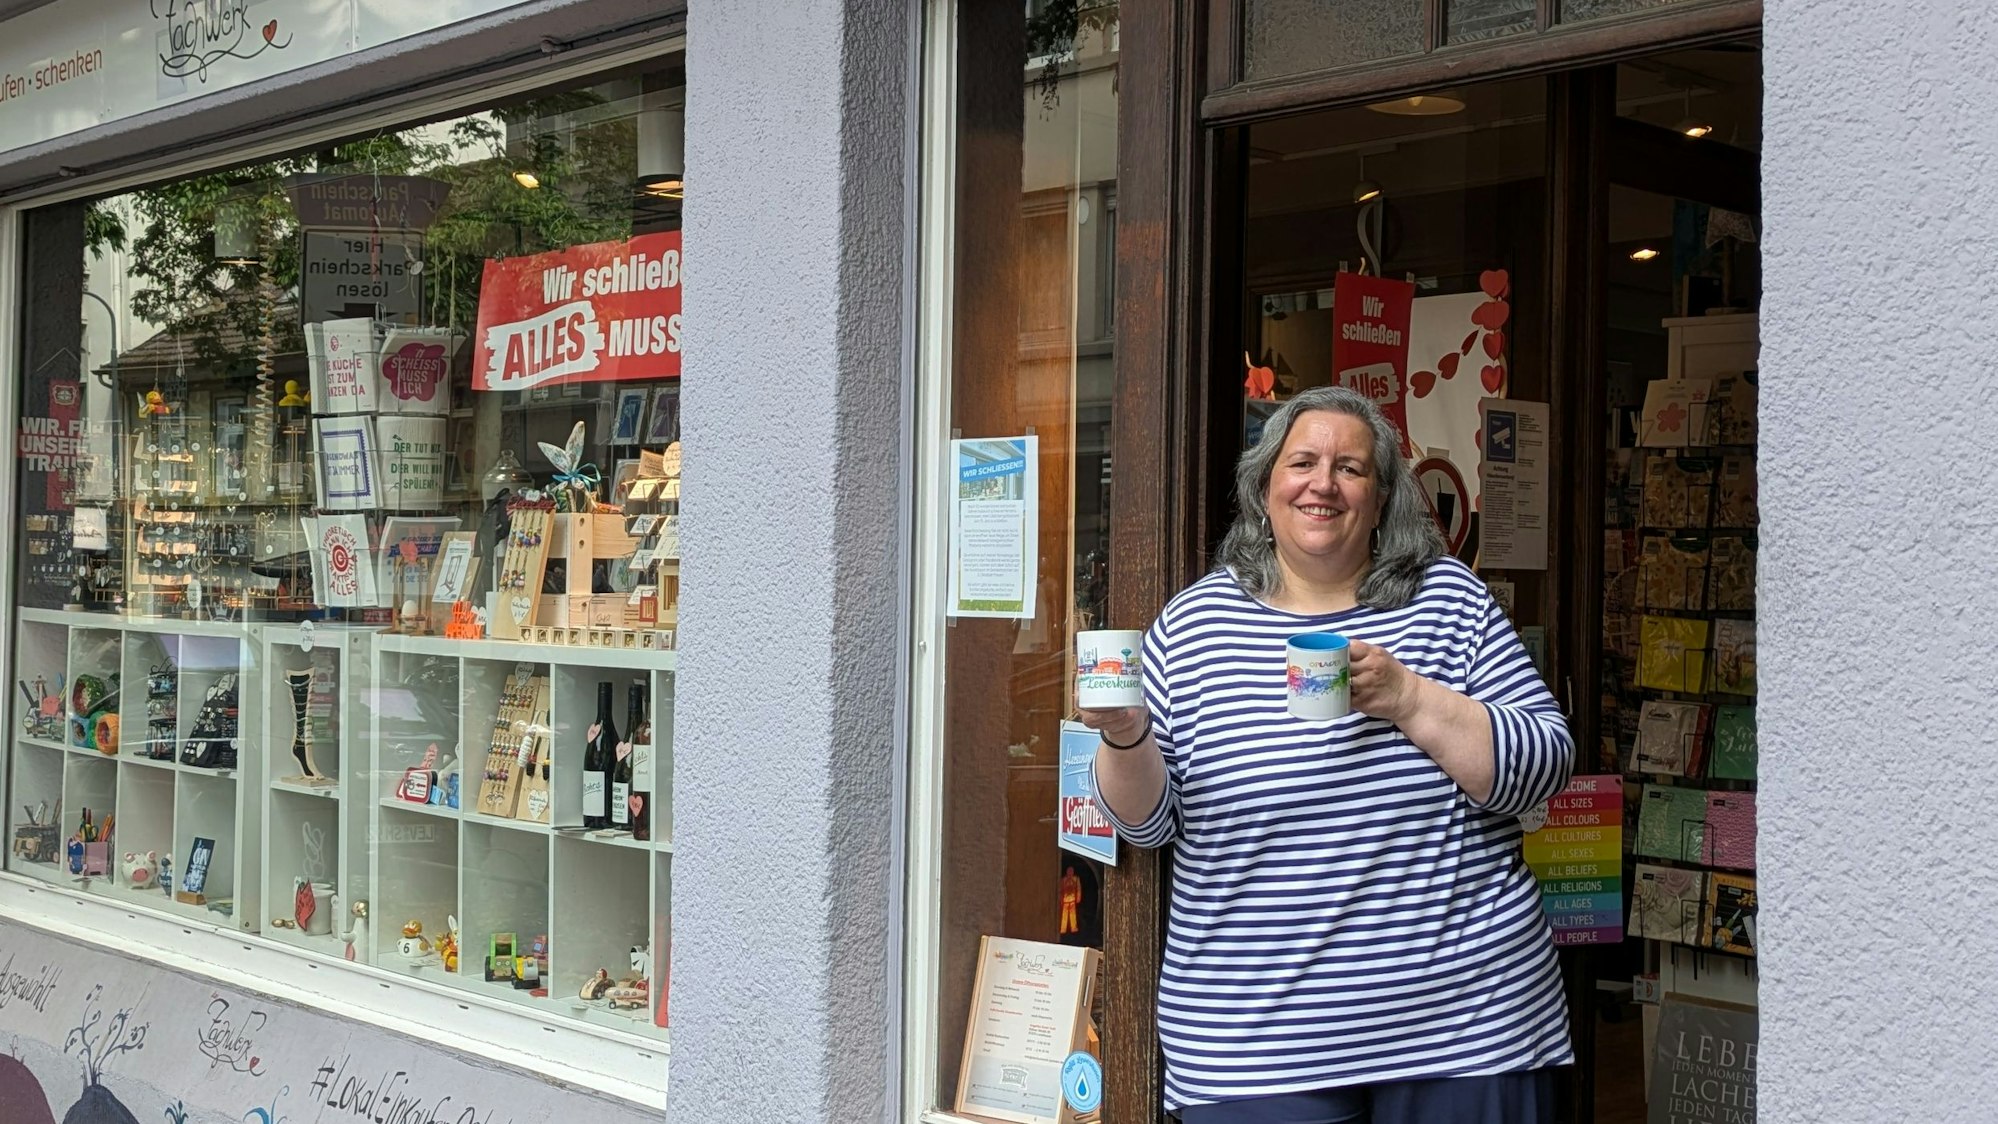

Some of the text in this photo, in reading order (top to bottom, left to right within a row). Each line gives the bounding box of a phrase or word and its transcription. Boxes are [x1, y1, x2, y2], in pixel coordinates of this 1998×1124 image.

[35, 48, 103, 91] schenken
[543, 249, 682, 304] Wir schließ
[1362, 295, 1385, 318] Wir
[1342, 320, 1402, 346] schließen
[502, 311, 682, 382] ALLES MUSS
[402, 382, 422, 394] ICH
[1349, 371, 1389, 398] Alles
[21, 416, 65, 436] WIR.
[962, 469, 977, 478] WIR
[329, 579, 358, 596] ALLES
[1553, 798, 1593, 809] ALL SIZES
[1546, 814, 1600, 826] ALL COLOURS
[1544, 831, 1602, 843] ALL CULTURES
[1551, 848, 1595, 859] ALL SEXES
[1548, 864, 1598, 877] ALL BELIEFS
[1543, 881, 1603, 894] ALL RELIGIONS
[1553, 898, 1592, 910] ALL AGES
[1552, 914, 1595, 927] ALL TYPES
[1567, 931, 1598, 943] PEOPLE
[402, 942, 411, 954] 6
[1671, 1060, 1704, 1075] JEDEN
[1668, 1096, 1716, 1120] JEDEN
